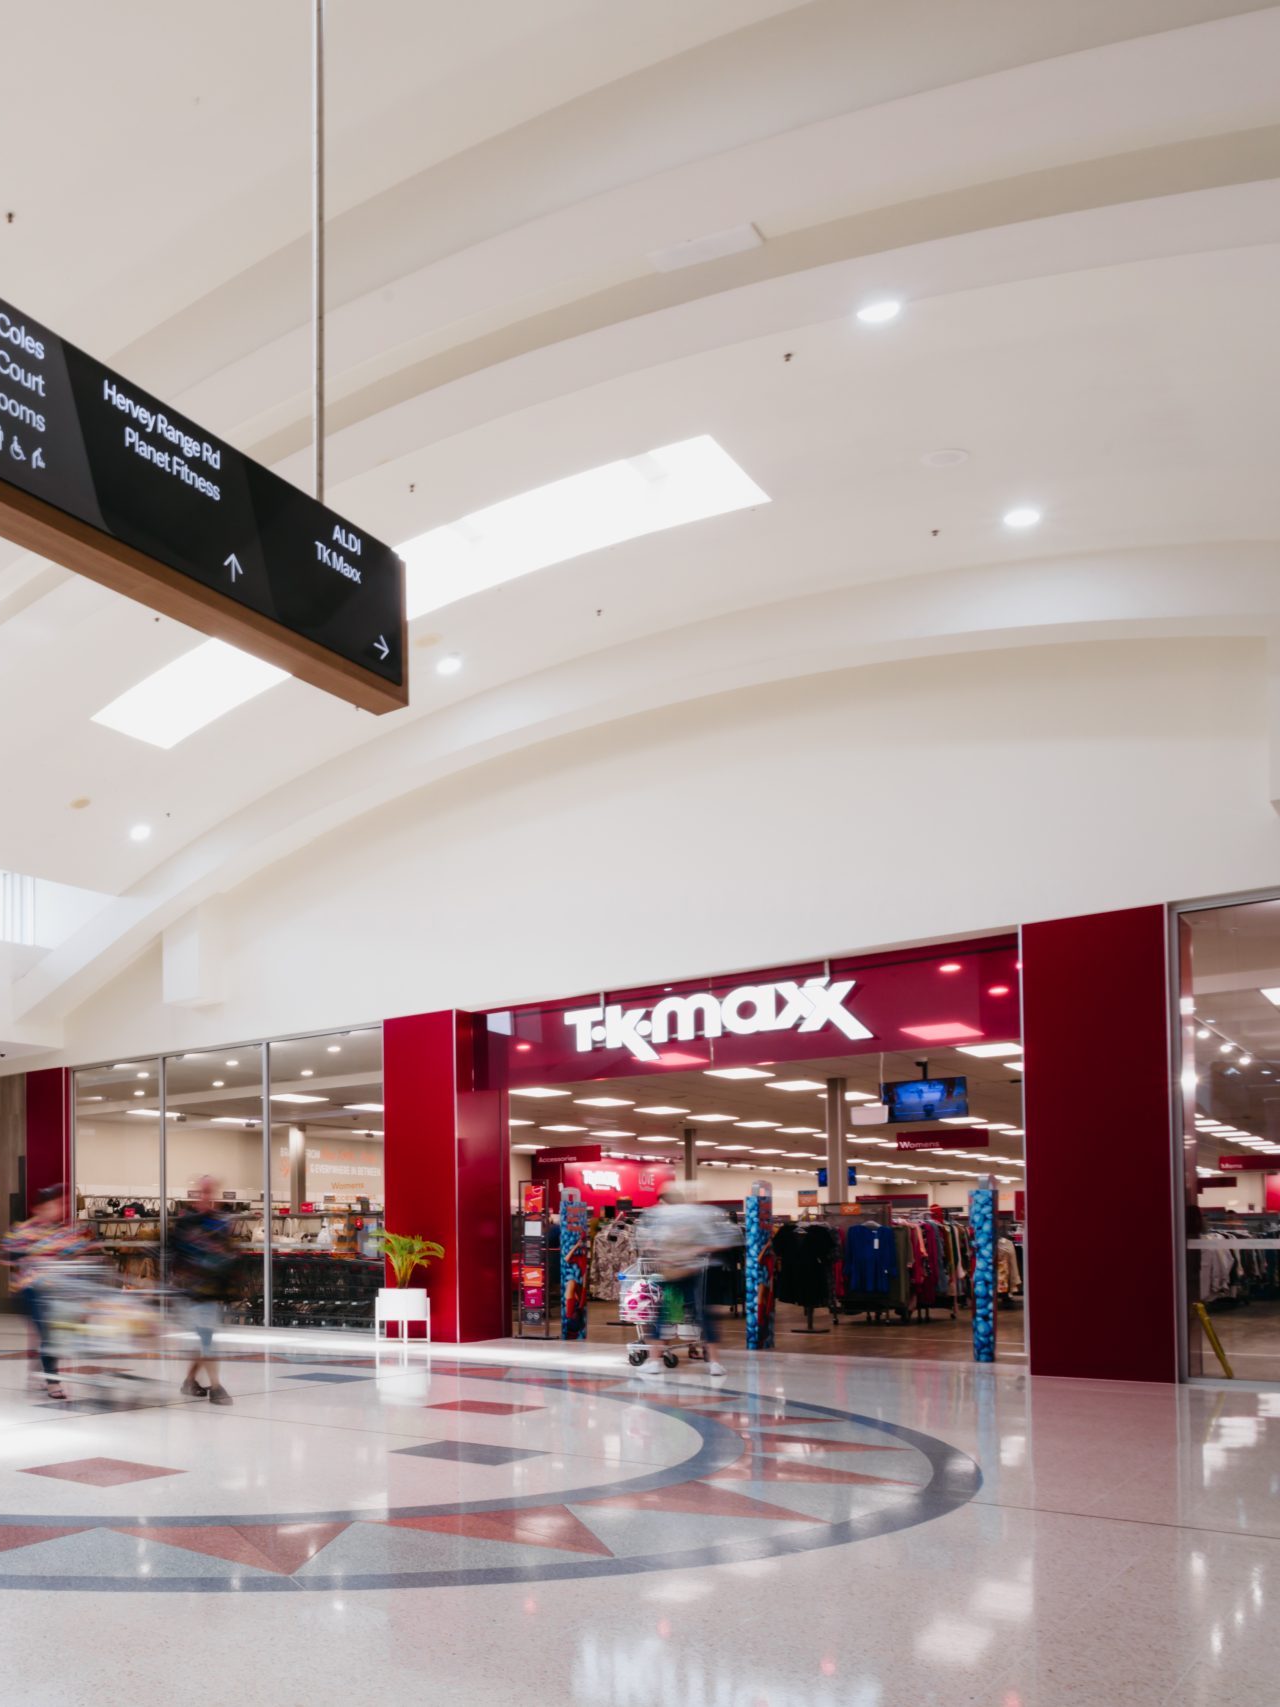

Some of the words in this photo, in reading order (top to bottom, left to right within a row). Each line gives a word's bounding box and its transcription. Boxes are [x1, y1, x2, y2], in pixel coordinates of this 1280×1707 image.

[103, 379, 156, 432] Hervey
[157, 413, 201, 457] Range
[202, 442, 221, 470] Rd
[124, 426, 171, 472] Planet
[172, 456, 221, 501] Fitness
[332, 525, 362, 555] ALDI
[314, 541, 332, 567] TK
[331, 551, 362, 585] Maxx
[899, 1141, 940, 1150] Womens
